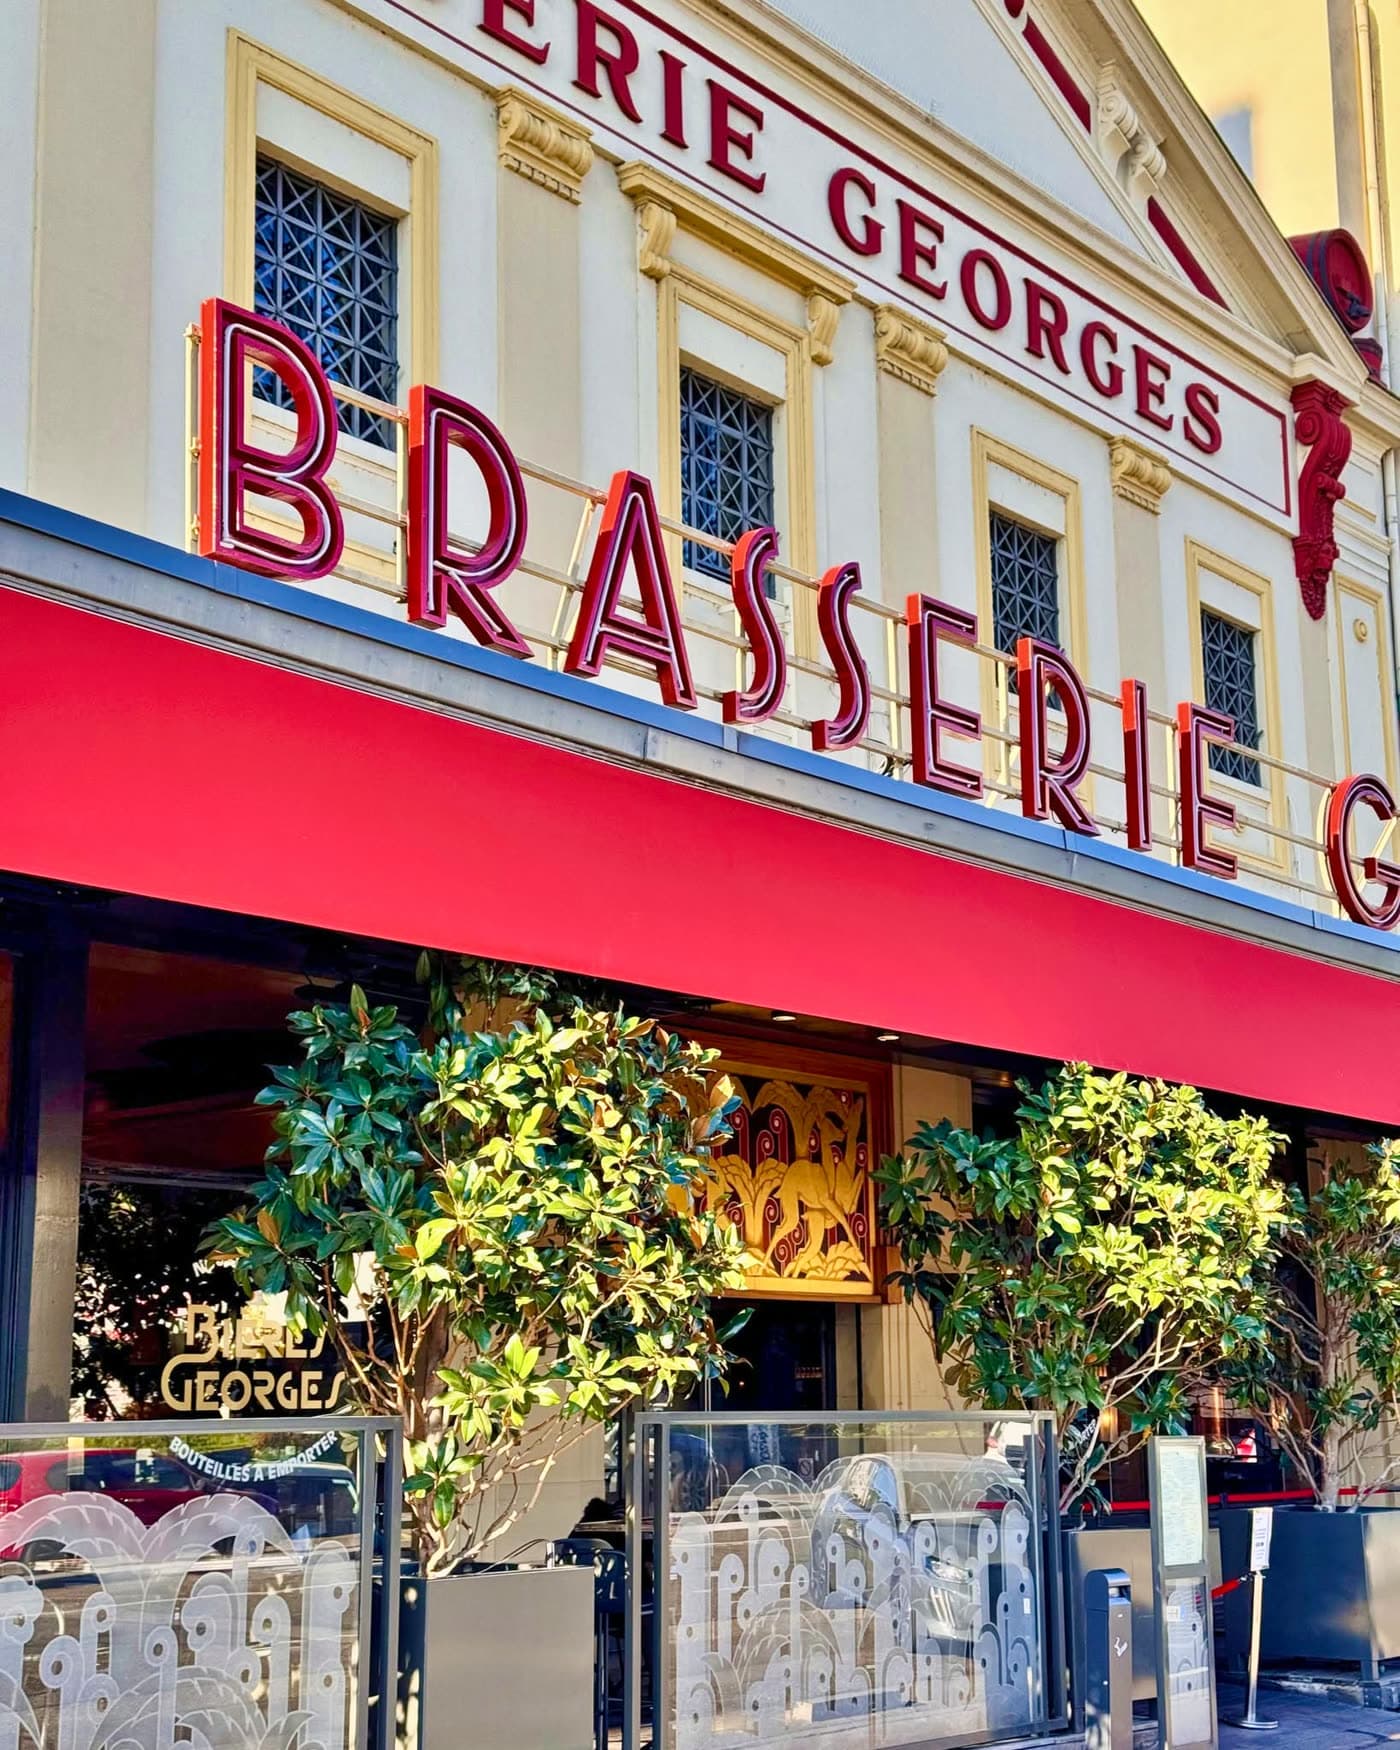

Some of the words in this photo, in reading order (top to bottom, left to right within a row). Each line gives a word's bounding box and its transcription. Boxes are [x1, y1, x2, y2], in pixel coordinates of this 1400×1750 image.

[828, 167, 1223, 454] GEORGES
[200, 297, 1238, 880] BRASSERIE
[160, 1354, 346, 1411] GEORGES
[169, 1436, 250, 1482] BOUTEILLES
[268, 1430, 338, 1479] EMPORTER
